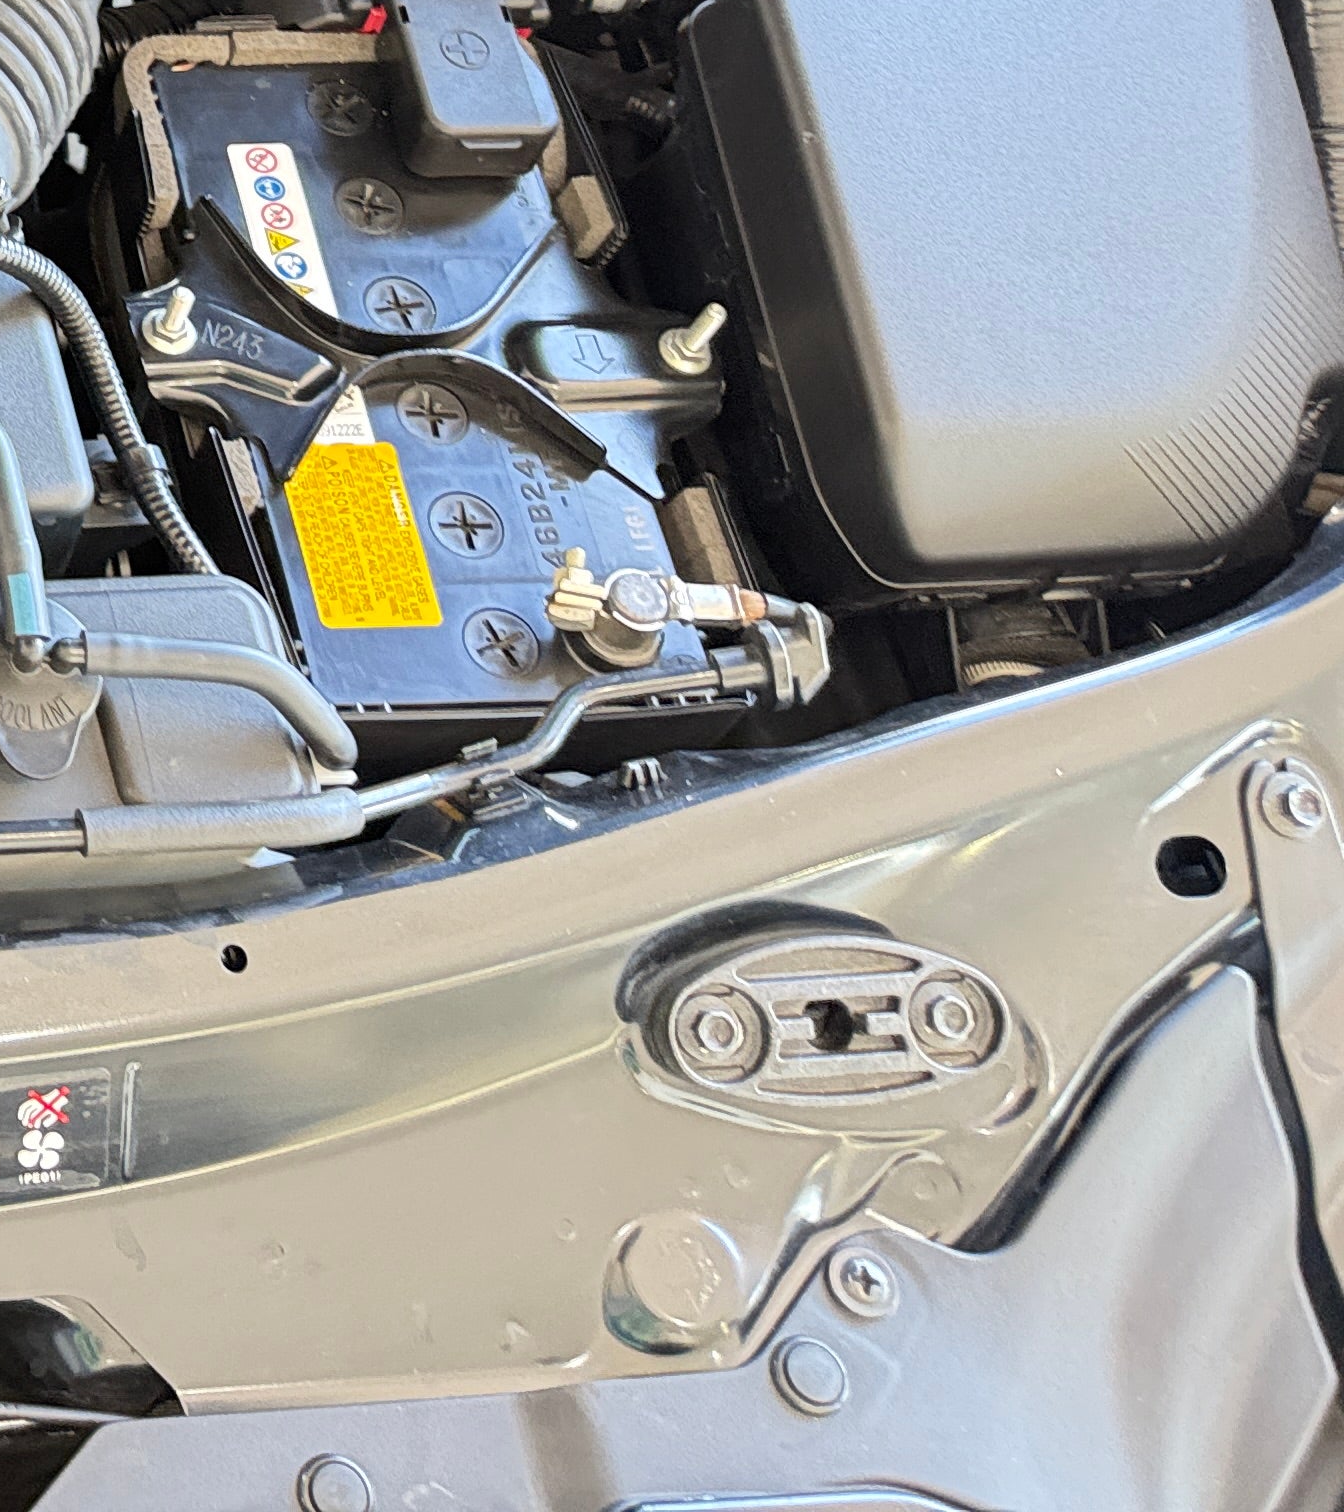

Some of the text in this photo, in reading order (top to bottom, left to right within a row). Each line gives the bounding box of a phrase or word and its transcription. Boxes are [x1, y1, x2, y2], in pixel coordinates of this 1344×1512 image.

[200, 318, 265, 361] N243
[327, 471, 352, 515] POISON
[383, 474, 411, 528] DANGER
